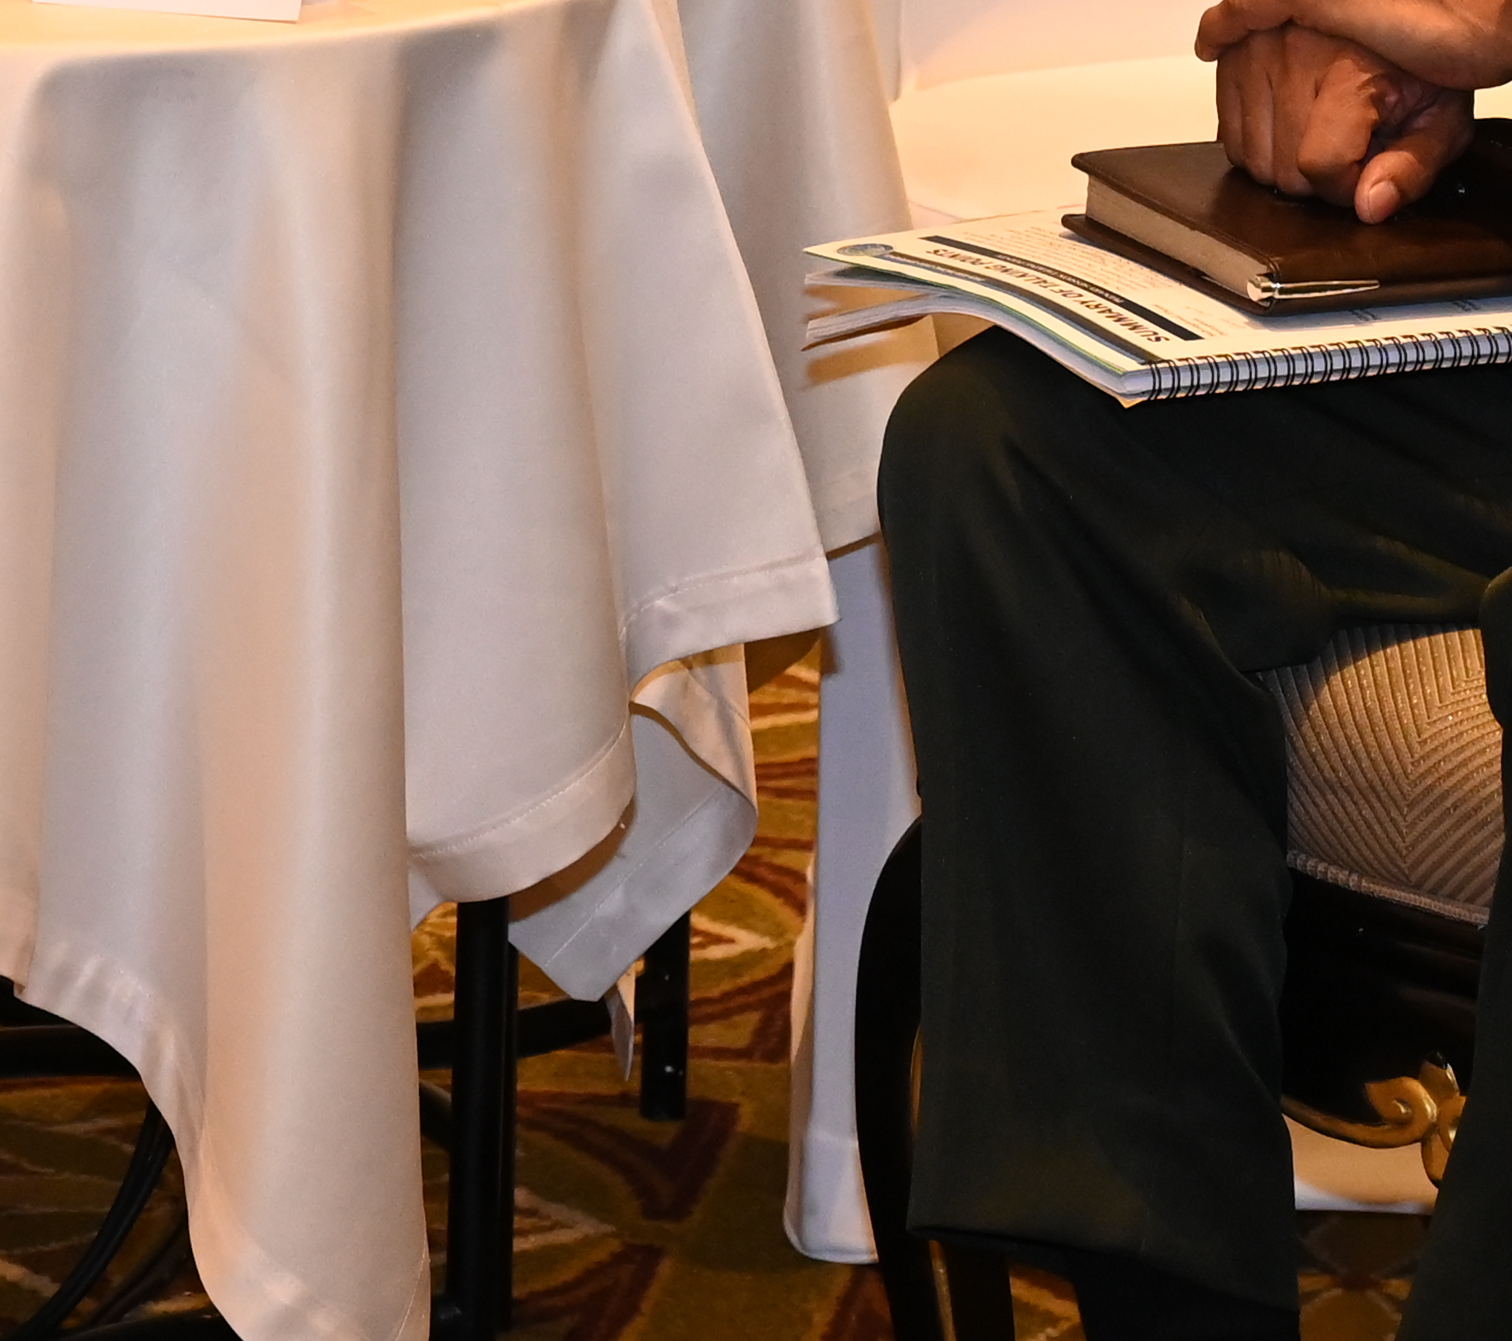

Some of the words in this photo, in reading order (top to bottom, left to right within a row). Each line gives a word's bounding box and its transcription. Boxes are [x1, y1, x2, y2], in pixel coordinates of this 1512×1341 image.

[925, 248, 994, 266] POINTS
[984, 263, 1061, 289] TALKING
[1049, 288, 1084, 299] OF
[1072, 299, 1171, 343] SUMMARY
